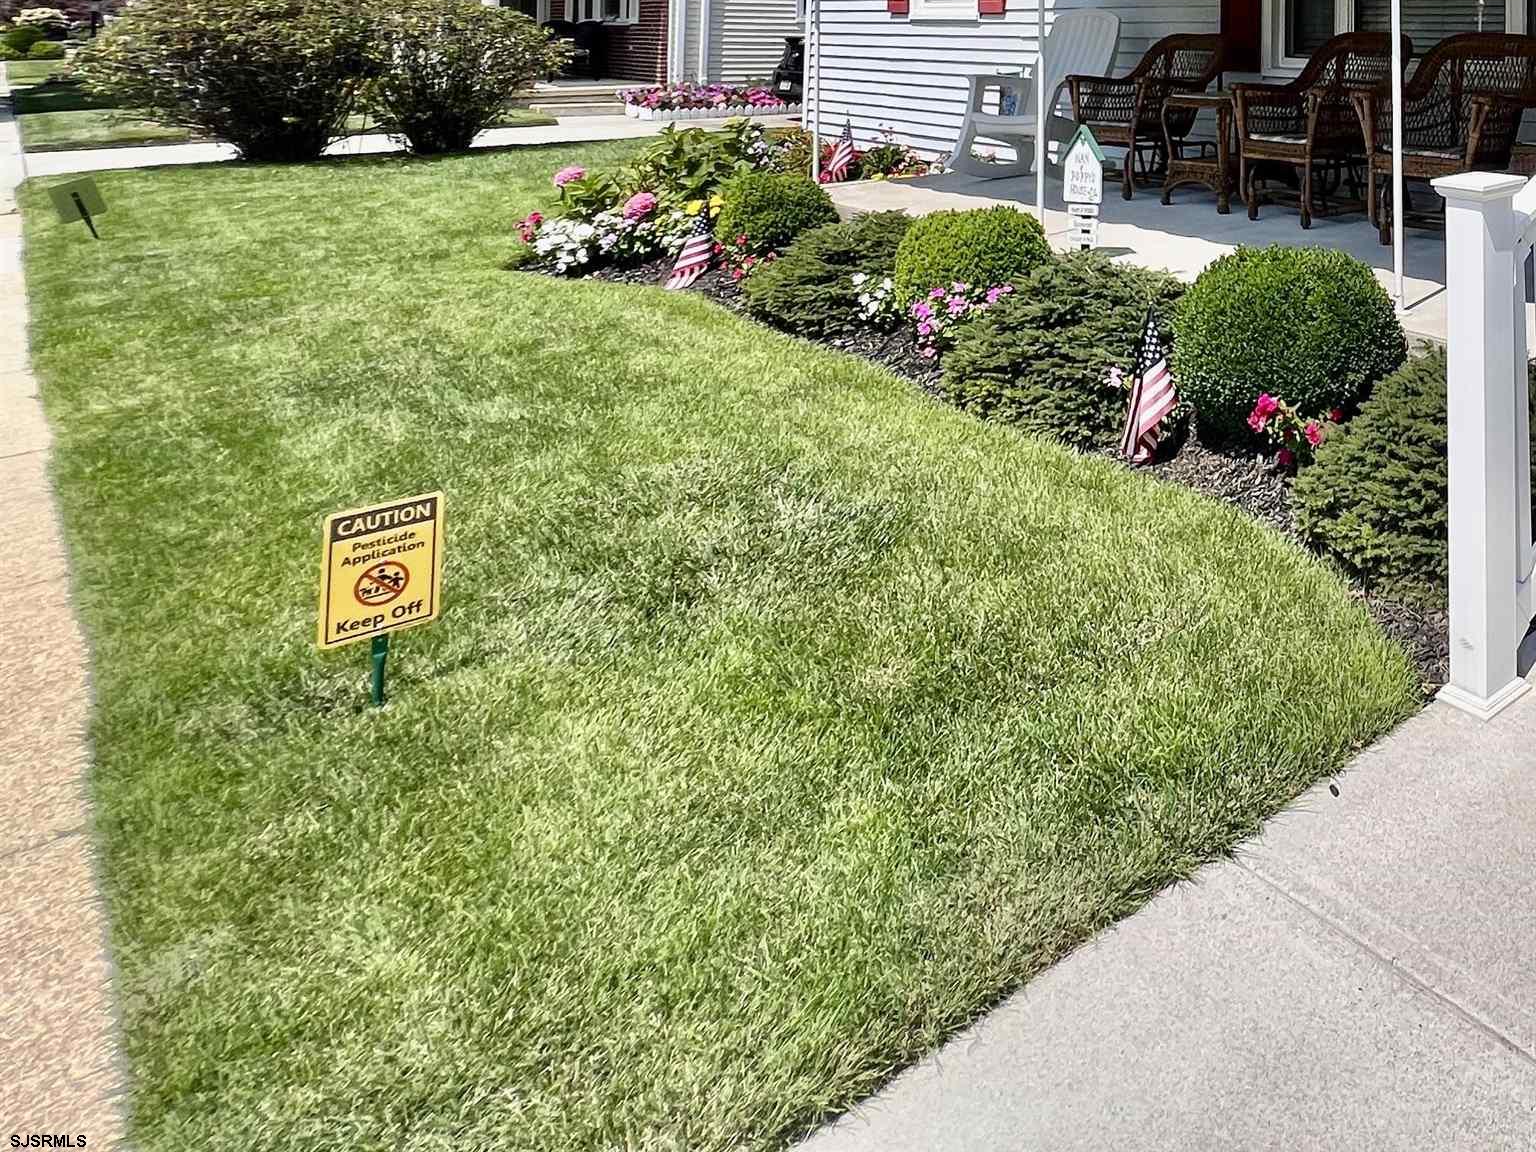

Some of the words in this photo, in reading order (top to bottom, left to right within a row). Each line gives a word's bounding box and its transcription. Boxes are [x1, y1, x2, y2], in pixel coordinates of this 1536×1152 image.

[336, 502, 432, 536] CAUTION
[340, 540, 426, 568] Application
[352, 531, 417, 553] Pesticide
[335, 613, 385, 635] Keep
[391, 600, 424, 619] Off
